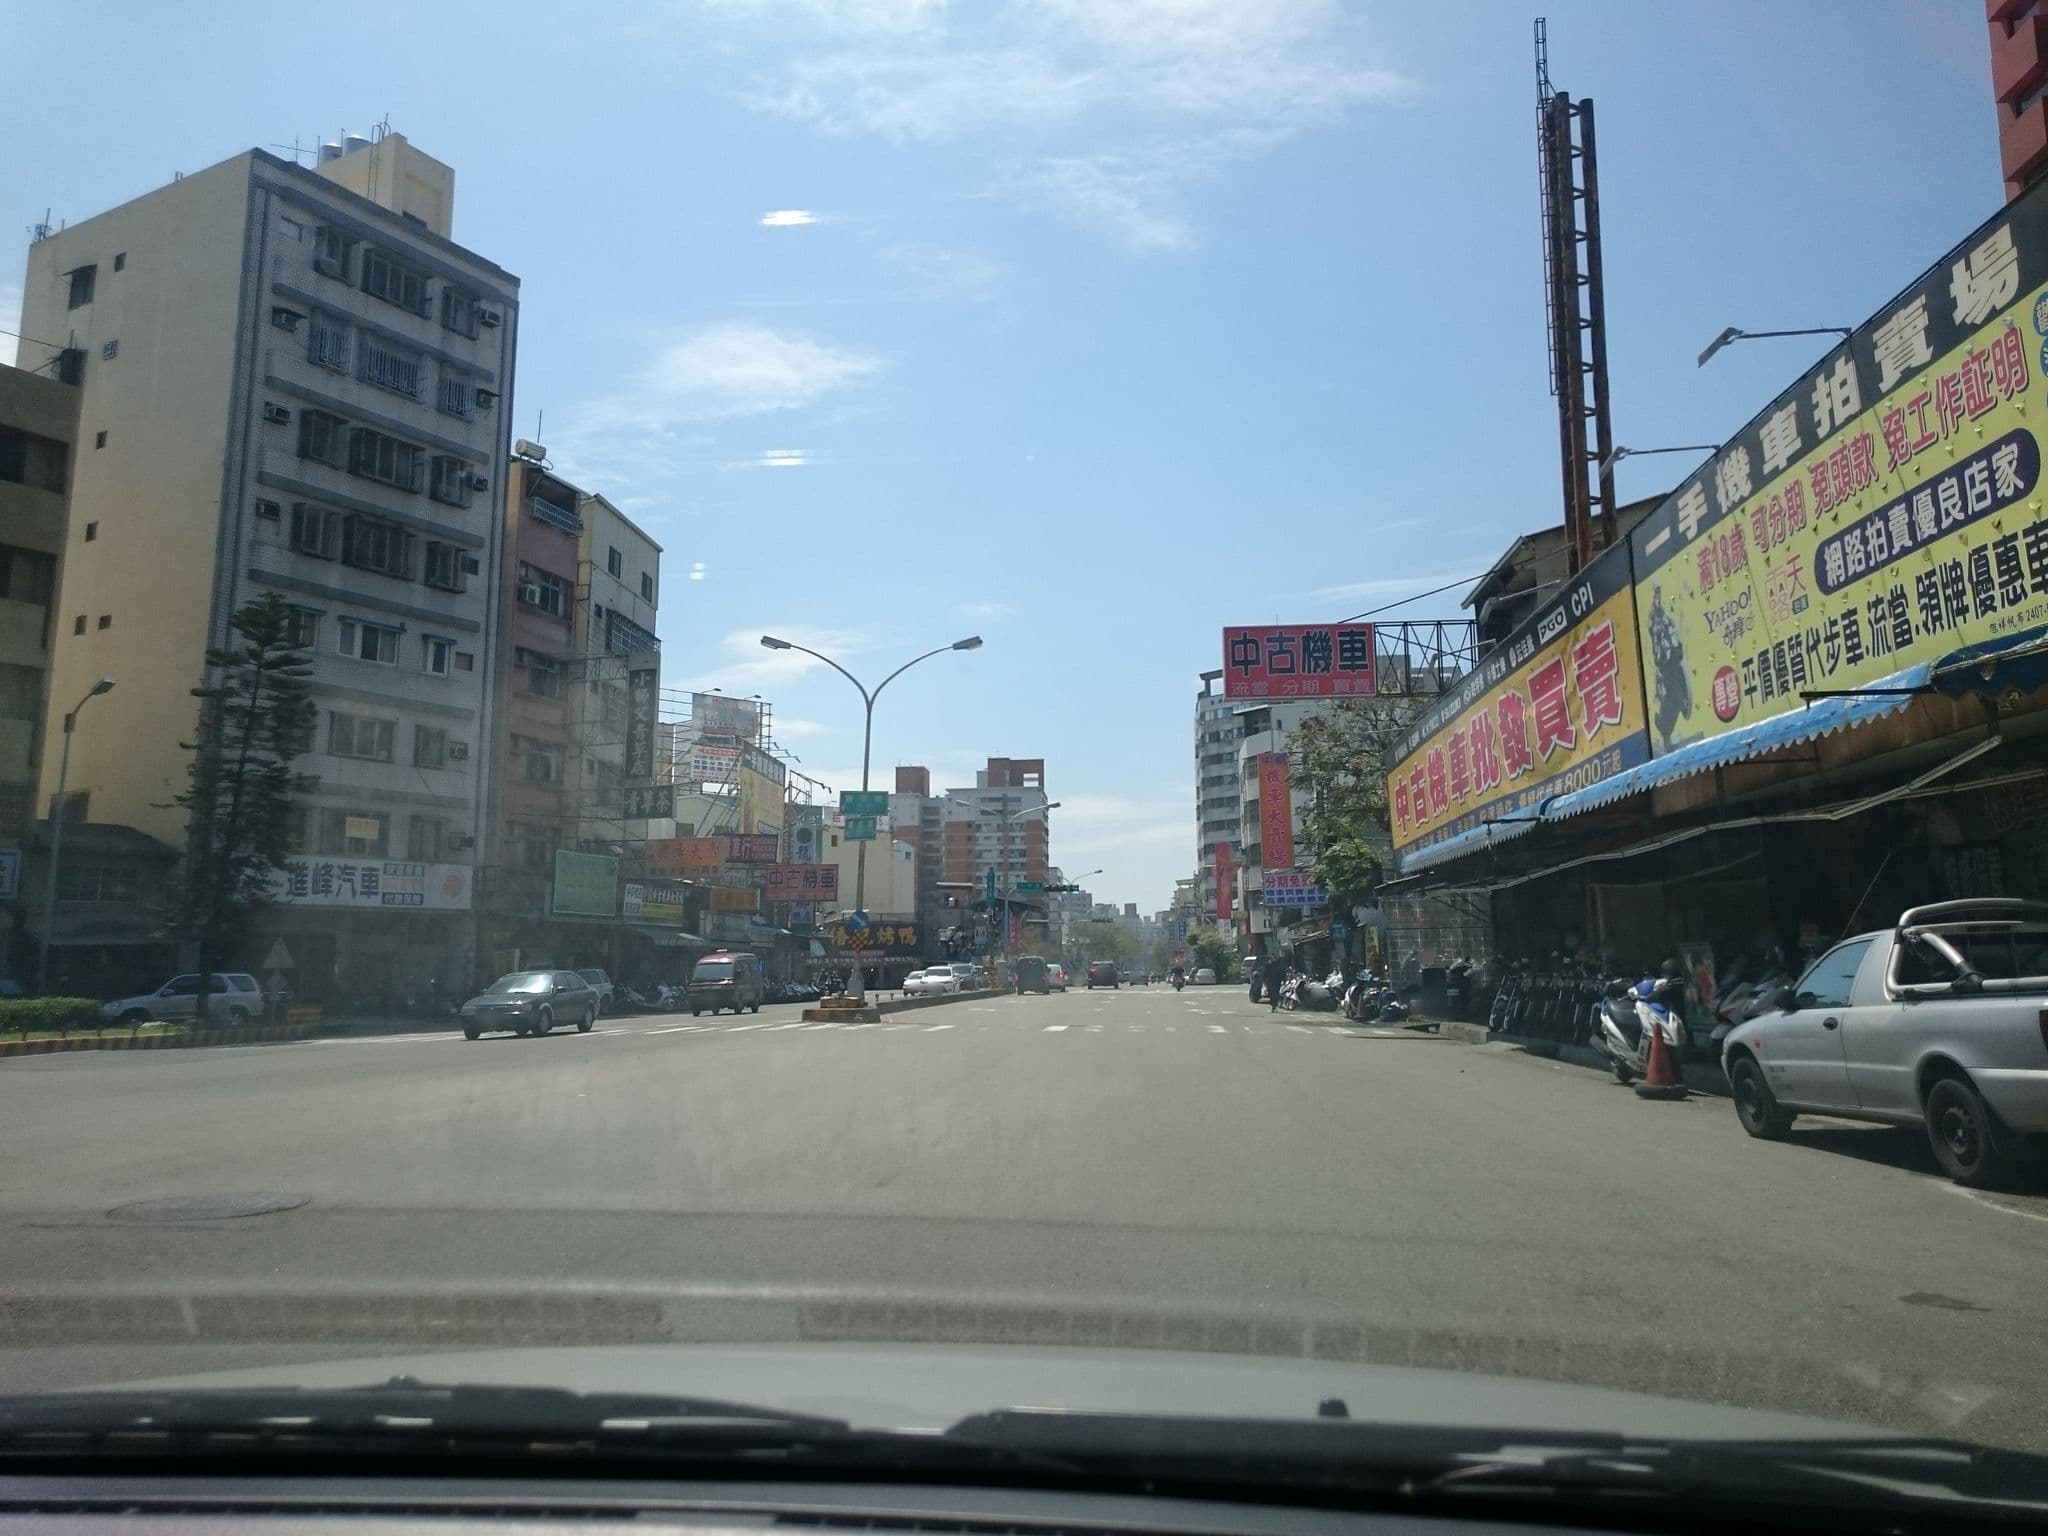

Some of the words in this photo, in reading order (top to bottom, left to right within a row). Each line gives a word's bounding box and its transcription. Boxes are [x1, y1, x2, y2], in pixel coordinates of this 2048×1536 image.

[1883, 326, 2030, 470] 免工作証明
[1822, 442, 2026, 585] 網路拍賣優良店家
[1539, 607, 1566, 642] PGO
[1571, 580, 1594, 617] CPI
[1704, 585, 1753, 634] YAHOO!
[1230, 628, 1369, 677] 中古機車
[1280, 680, 1320, 694] 分期
[1394, 618, 1623, 837] 中古機車批發買賣
